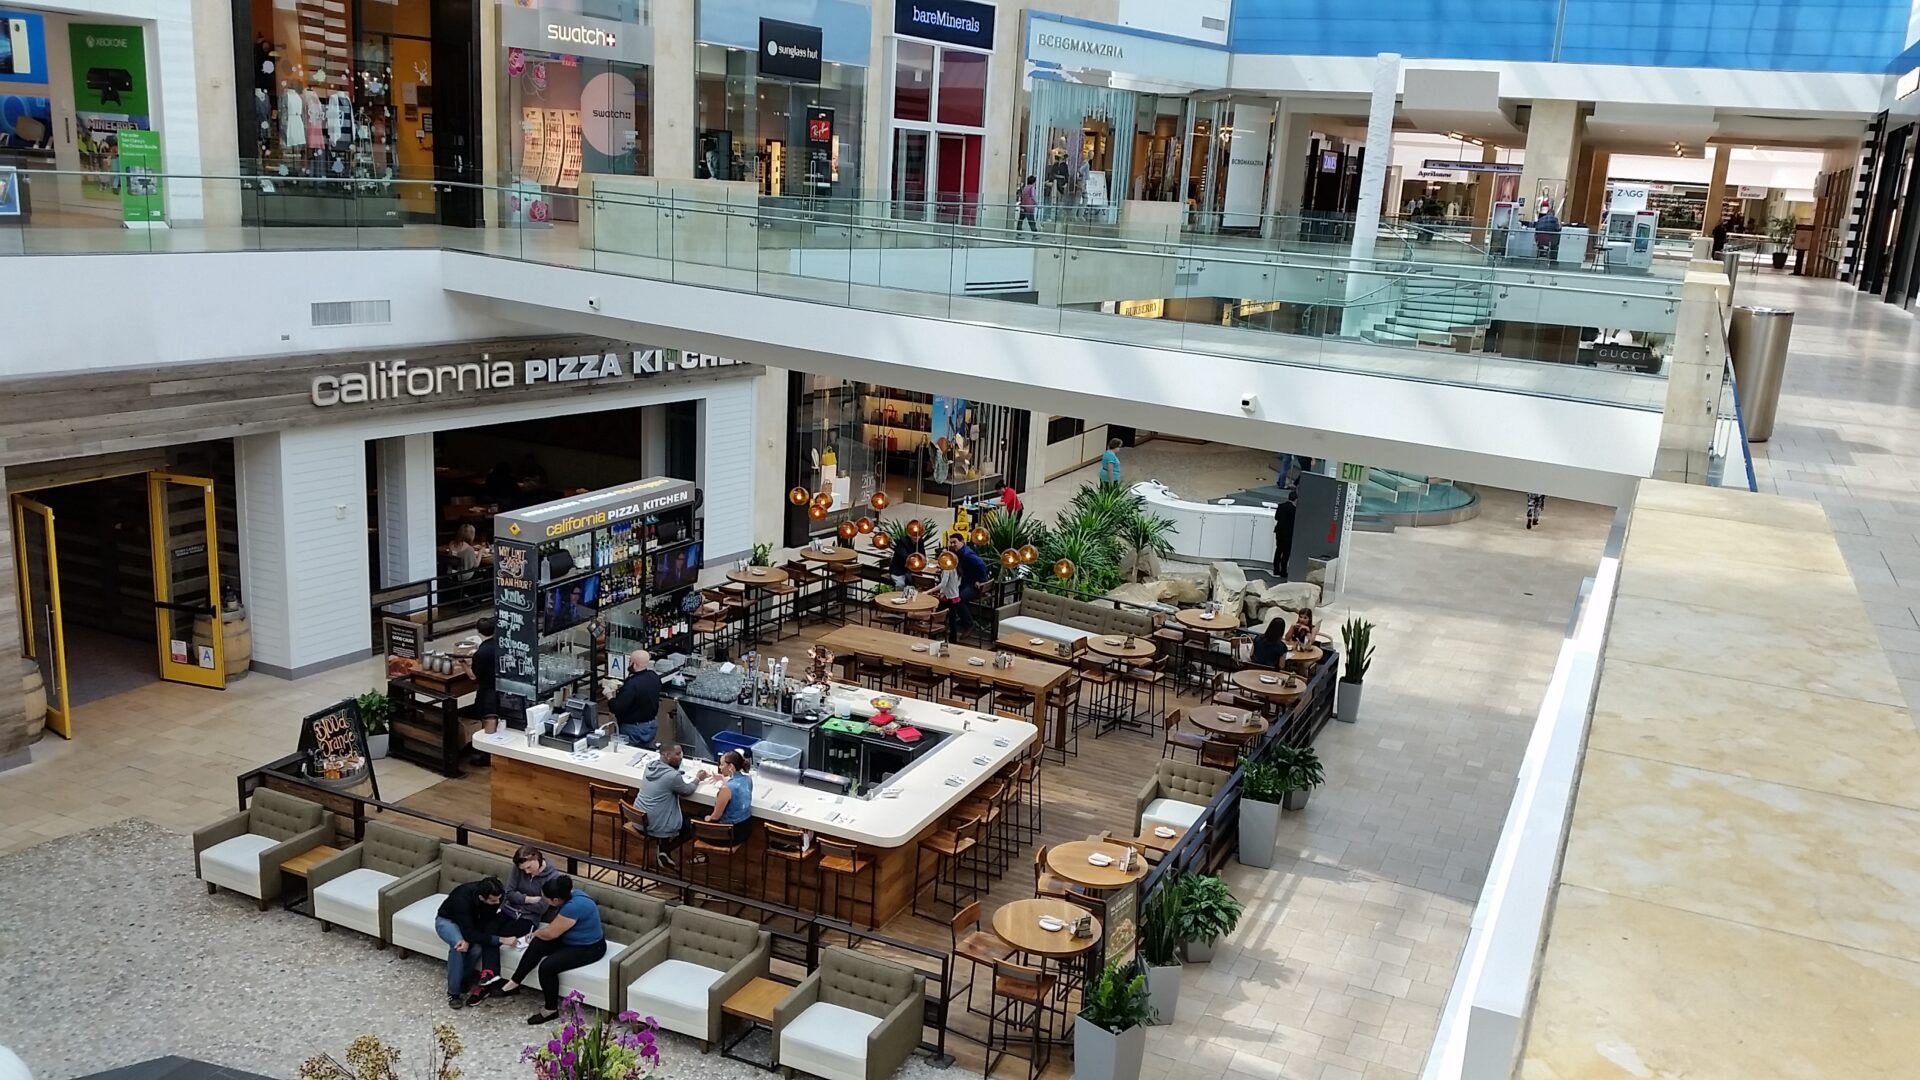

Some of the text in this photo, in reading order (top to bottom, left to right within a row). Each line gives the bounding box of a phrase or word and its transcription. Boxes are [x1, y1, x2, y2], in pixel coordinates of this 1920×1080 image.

[912, 5, 980, 33] bareMinerals
[547, 24, 606, 47] swatch
[778, 45, 818, 60] sunglass hut
[1038, 33, 1124, 59] BCBGMAXAZRIA
[592, 109, 625, 119] swatch
[1617, 189, 1644, 198] ZAGG
[1599, 348, 1647, 361] GUCCI
[312, 353, 515, 408] california
[525, 352, 623, 385] PIZZA
[1342, 462, 1365, 482] EXIT
[546, 490, 688, 537] california PIZZA KITCHEN
[203, 650, 212, 661] A
[611, 657, 621, 671] A
[313, 709, 350, 741] Blood
